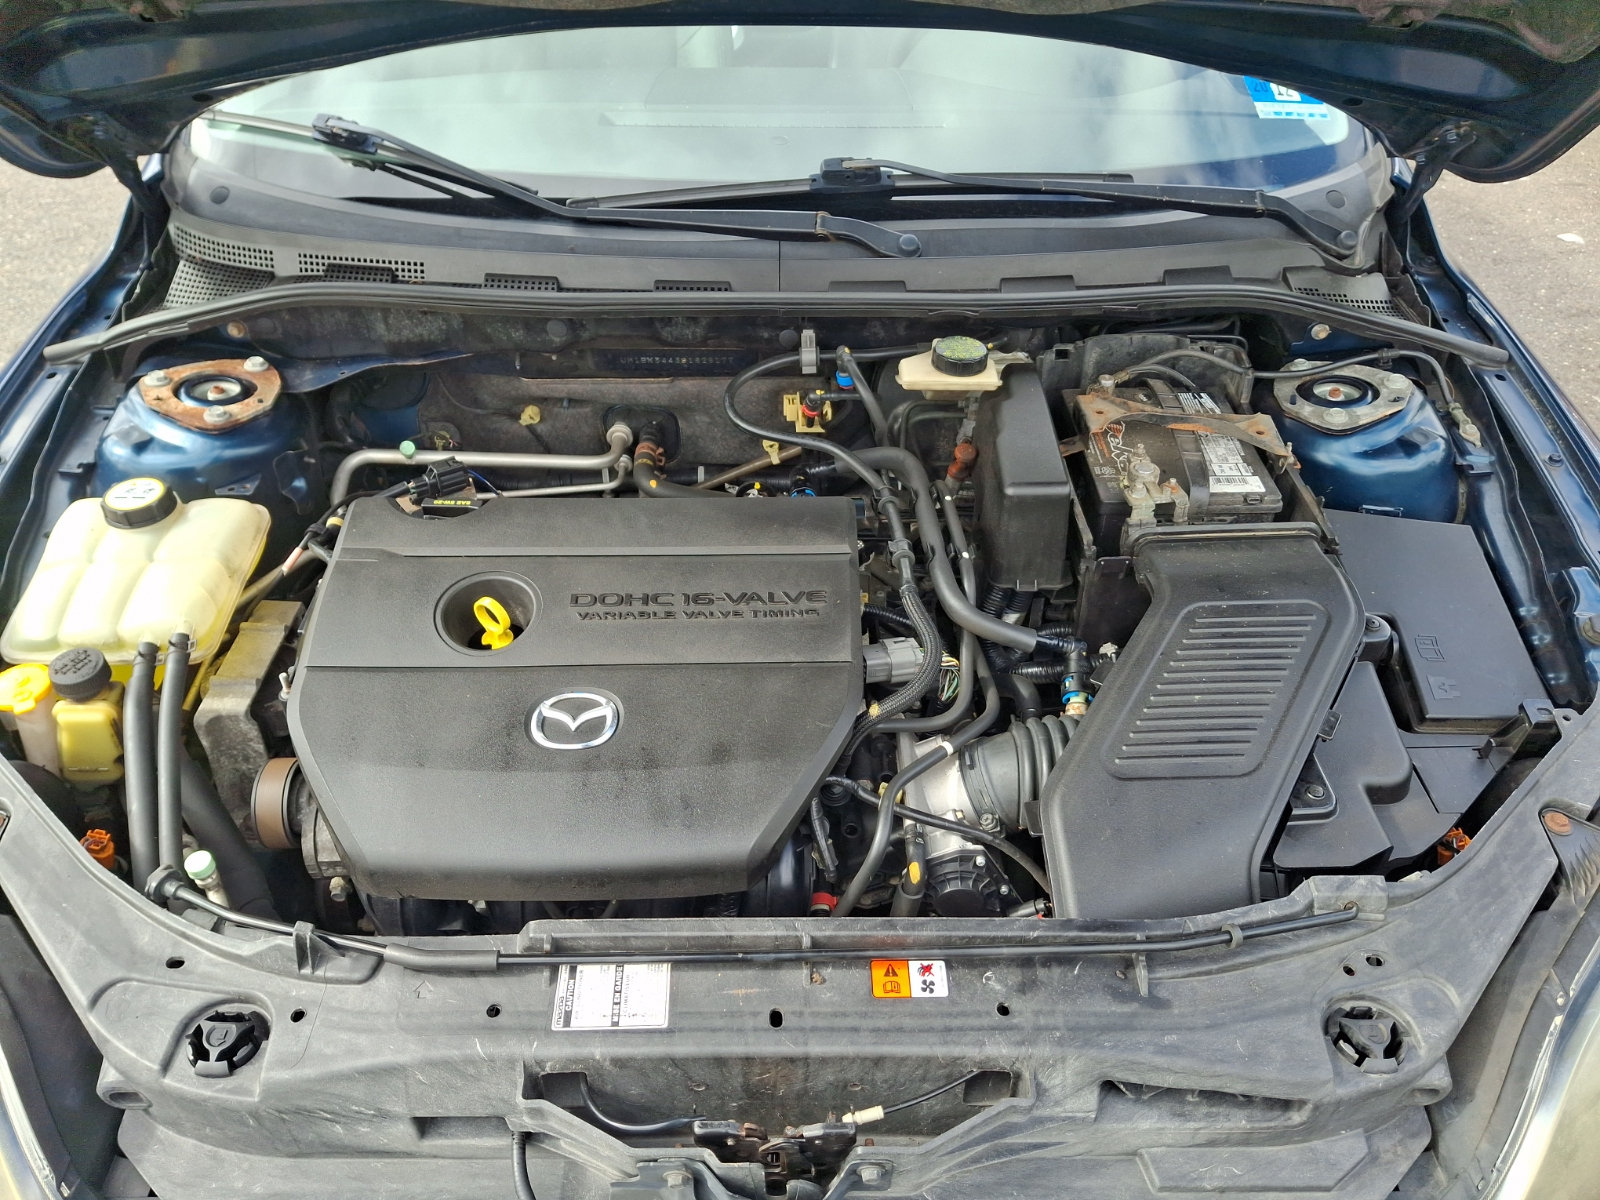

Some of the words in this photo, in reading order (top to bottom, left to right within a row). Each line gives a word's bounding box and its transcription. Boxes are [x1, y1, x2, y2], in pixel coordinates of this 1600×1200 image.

[570, 592, 675, 607] DOHC
[681, 590, 827, 606] 16-VALVE
[577, 610, 676, 620] VARIABLE
[682, 609, 745, 619] VALVE
[749, 608, 820, 618] TIMING
[614, 966, 623, 991] GARDE
[565, 979, 575, 1011] CAUTION
[613, 992, 621, 1003] EN
